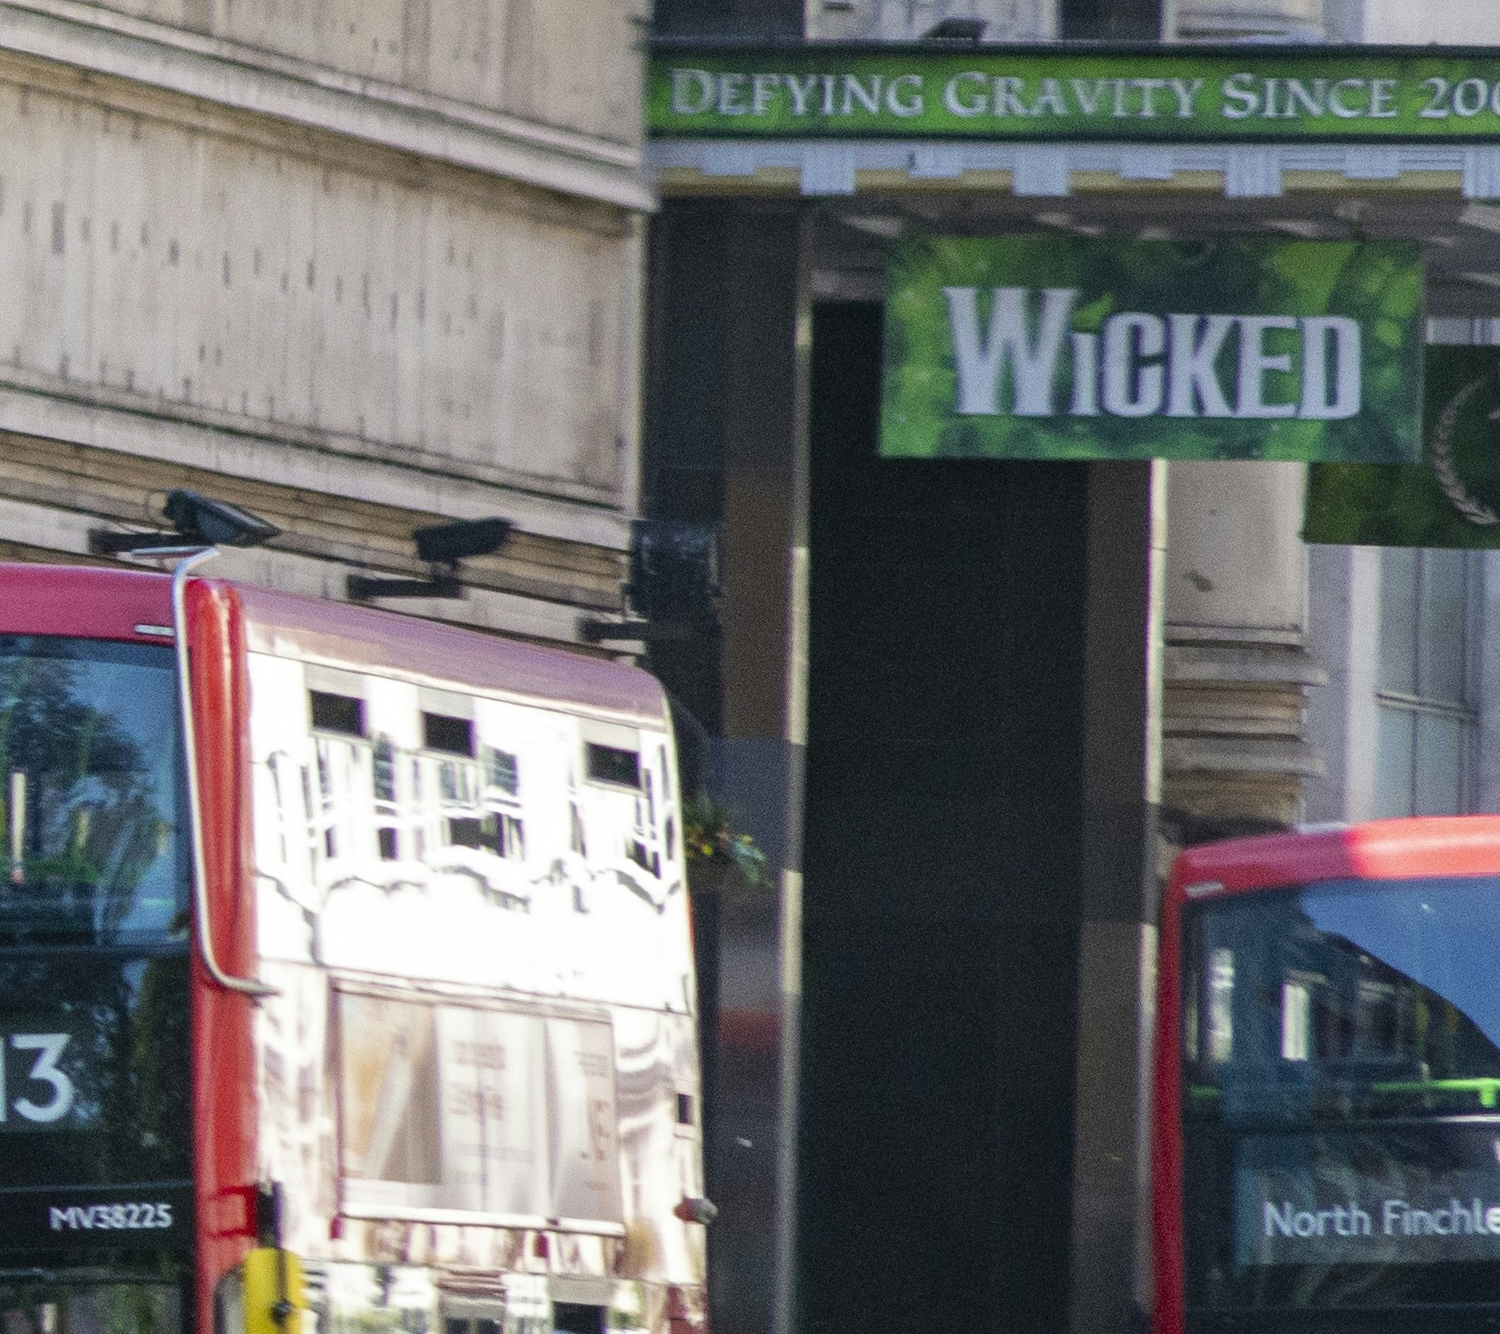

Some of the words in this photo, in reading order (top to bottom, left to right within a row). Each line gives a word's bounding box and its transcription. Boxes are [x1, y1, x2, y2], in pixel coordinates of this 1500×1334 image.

[1417, 75, 1500, 121] 20
[48, 1201, 174, 1234] MV38225
[1262, 1199, 1373, 1238] North
